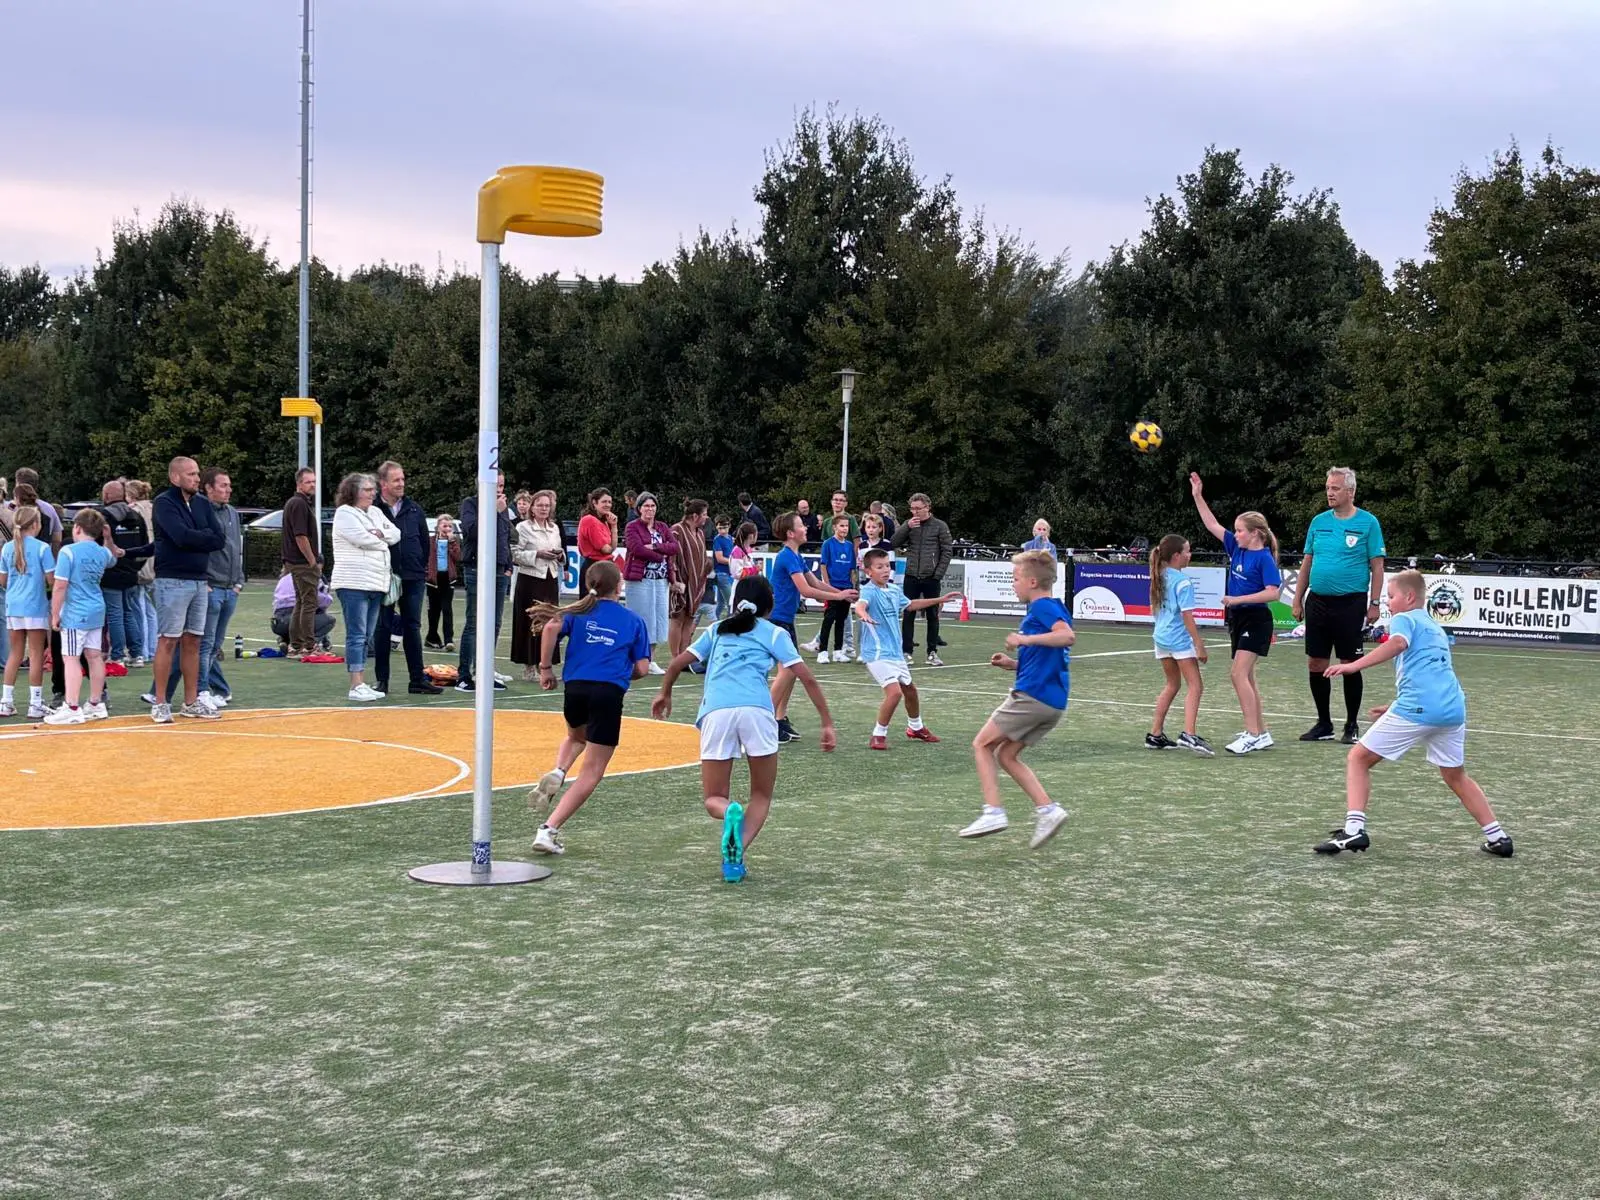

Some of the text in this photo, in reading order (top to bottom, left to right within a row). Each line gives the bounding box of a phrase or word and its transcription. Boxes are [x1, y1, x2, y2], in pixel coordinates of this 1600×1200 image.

[489, 446, 499, 470] 2
[1474, 584, 1598, 613] DE GILLENDE
[1479, 607, 1571, 629] KEUKENMEID
